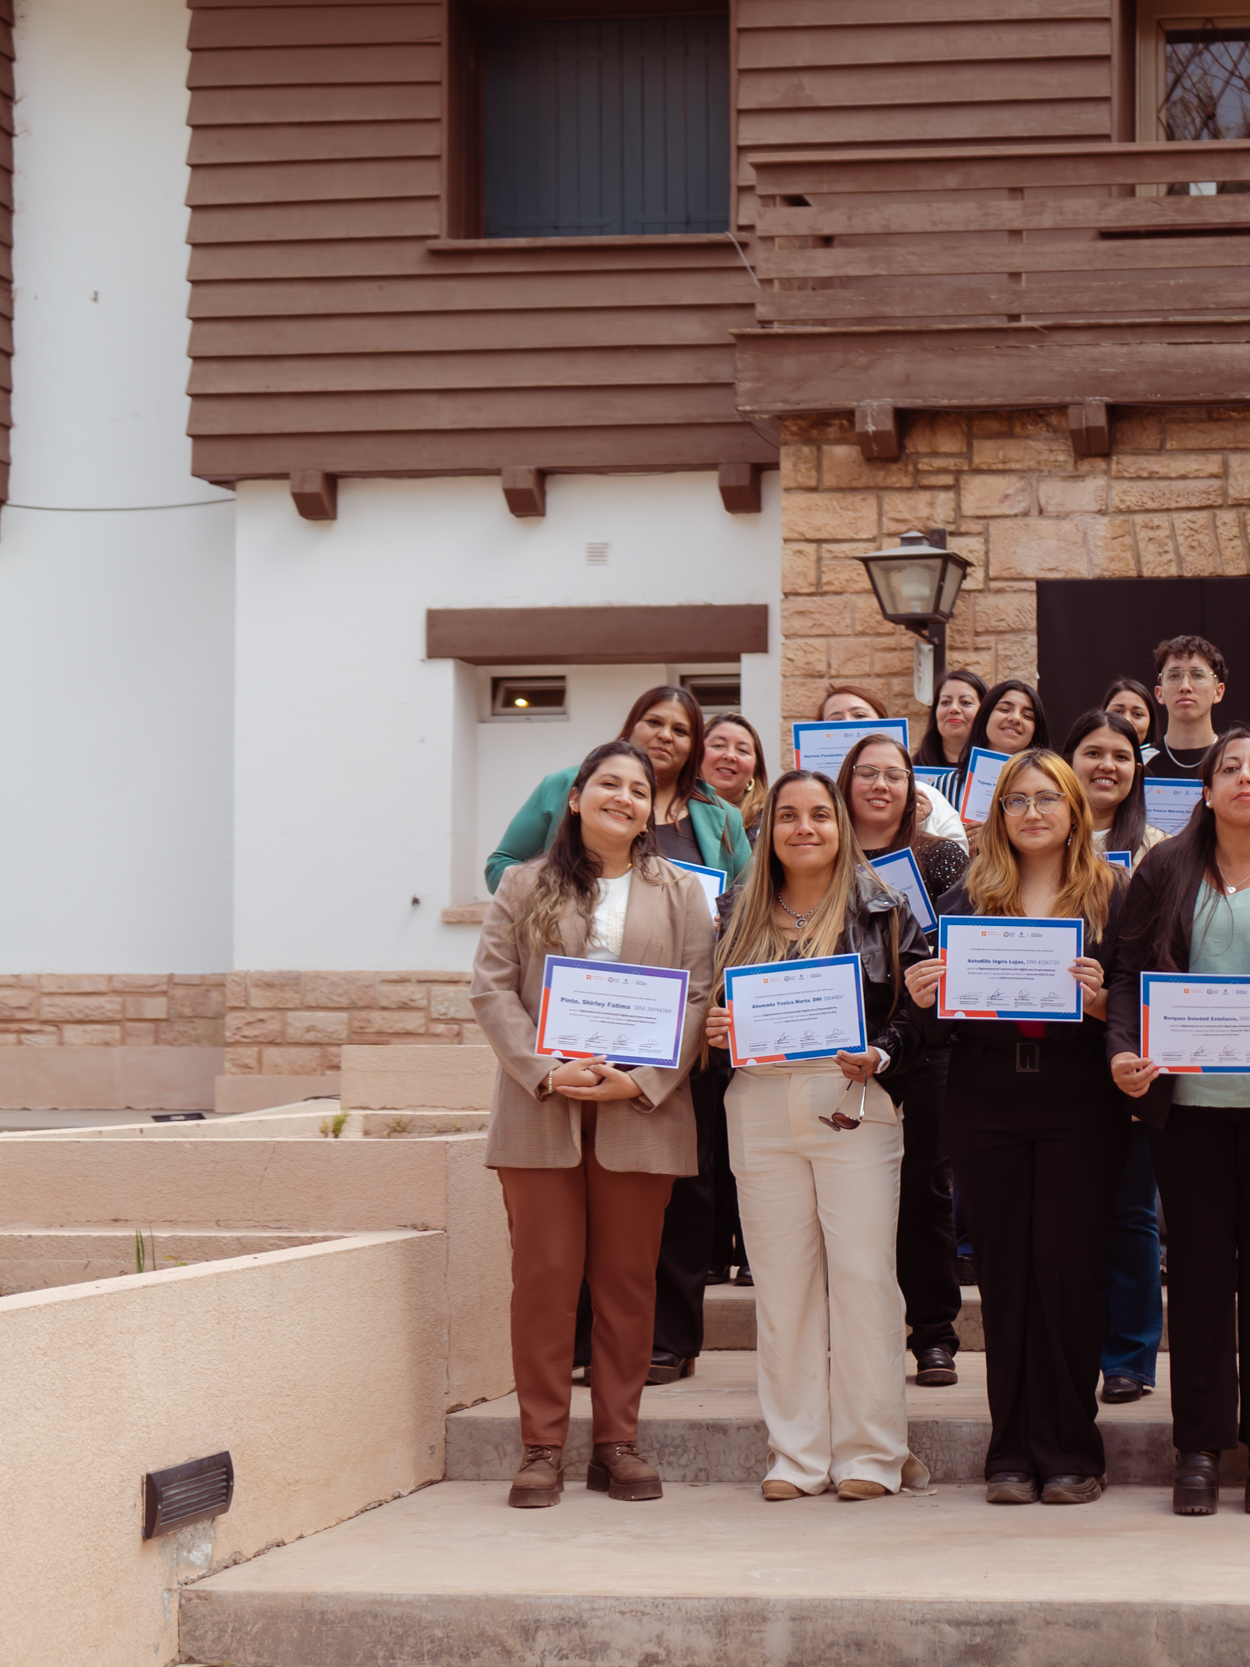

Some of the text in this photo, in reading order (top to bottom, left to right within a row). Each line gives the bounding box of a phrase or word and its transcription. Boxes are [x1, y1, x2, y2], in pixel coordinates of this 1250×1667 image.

[560, 997, 580, 1005] Pinto,
[582, 999, 606, 1008] Shirley
[634, 1004, 646, 1012] DNI
